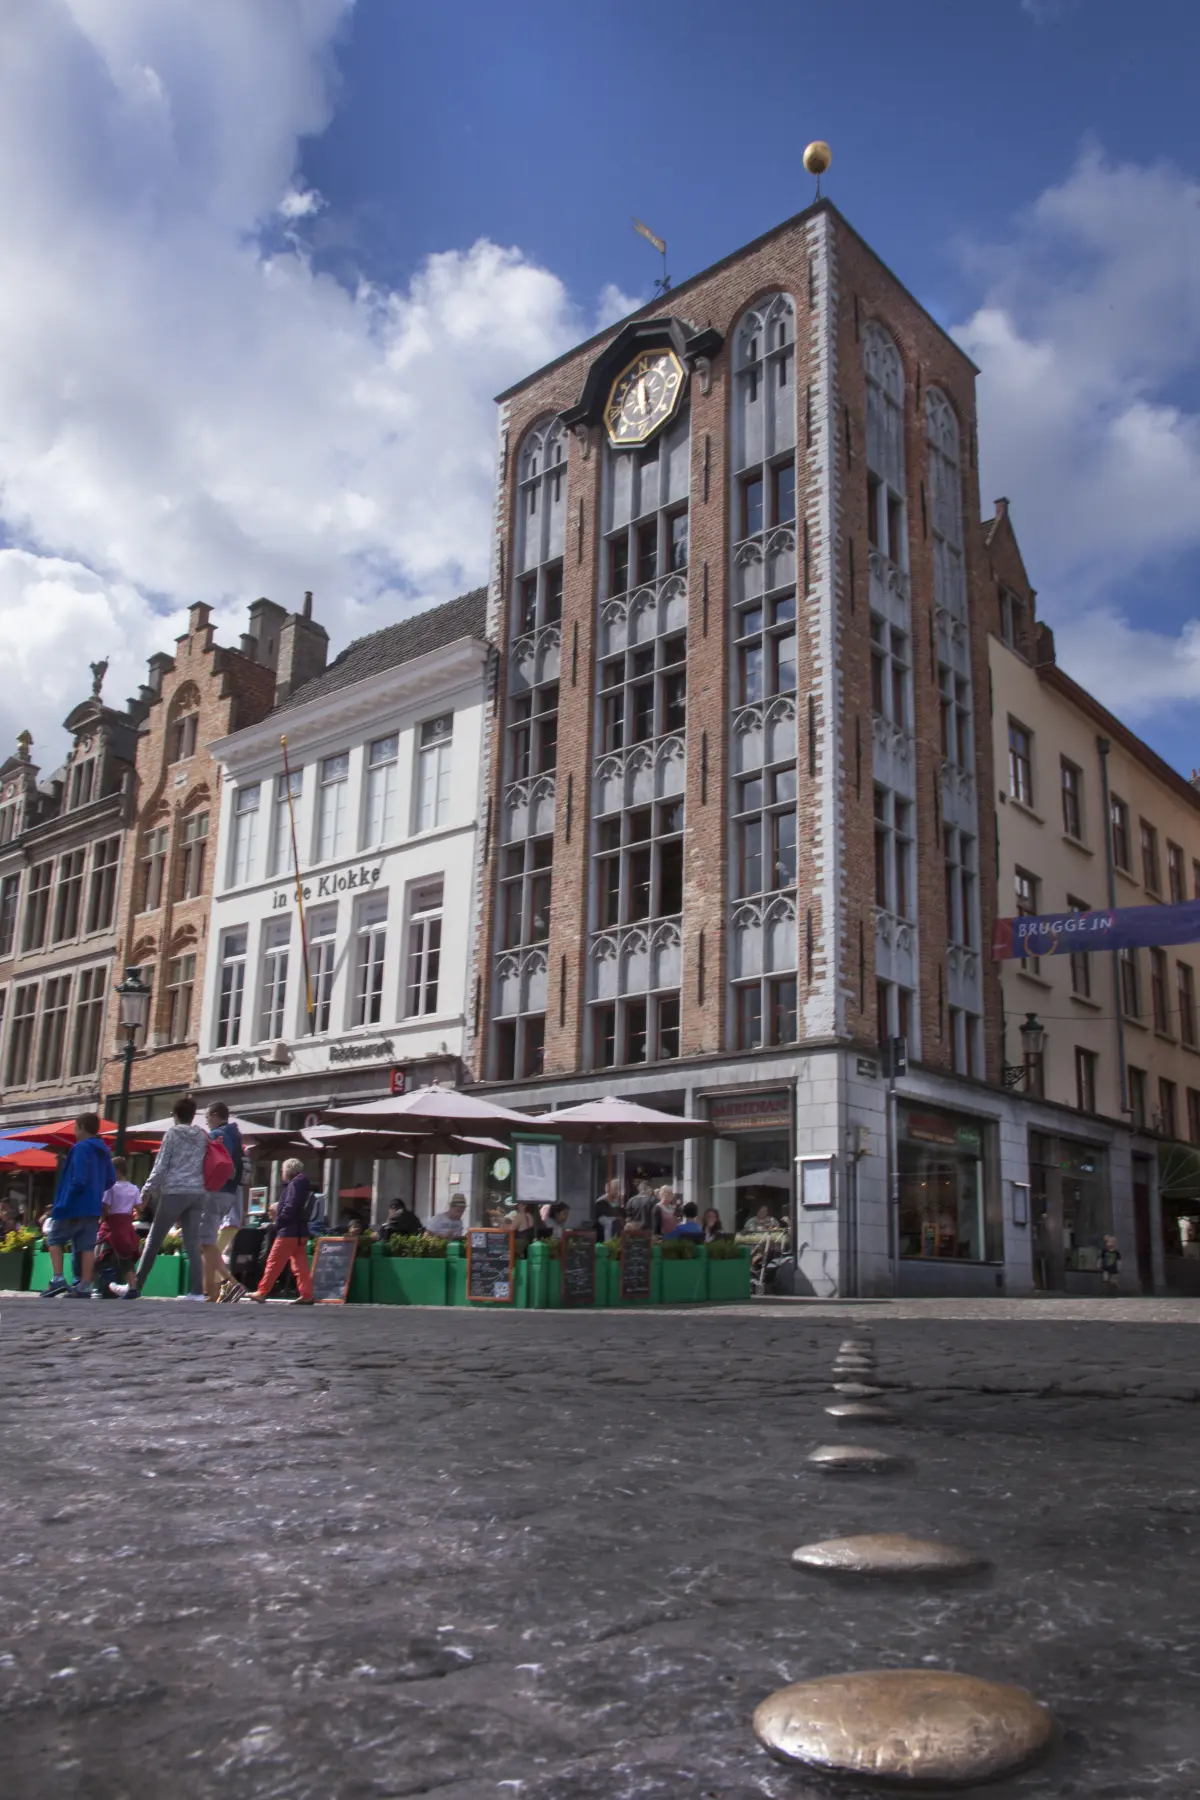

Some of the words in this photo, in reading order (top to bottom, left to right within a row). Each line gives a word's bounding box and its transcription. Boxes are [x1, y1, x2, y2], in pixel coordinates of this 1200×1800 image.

[272, 891, 287, 910] in
[294, 882, 312, 902] de
[317, 866, 380, 898] Klokke
[1018, 918, 1086, 938] BRUGGE
